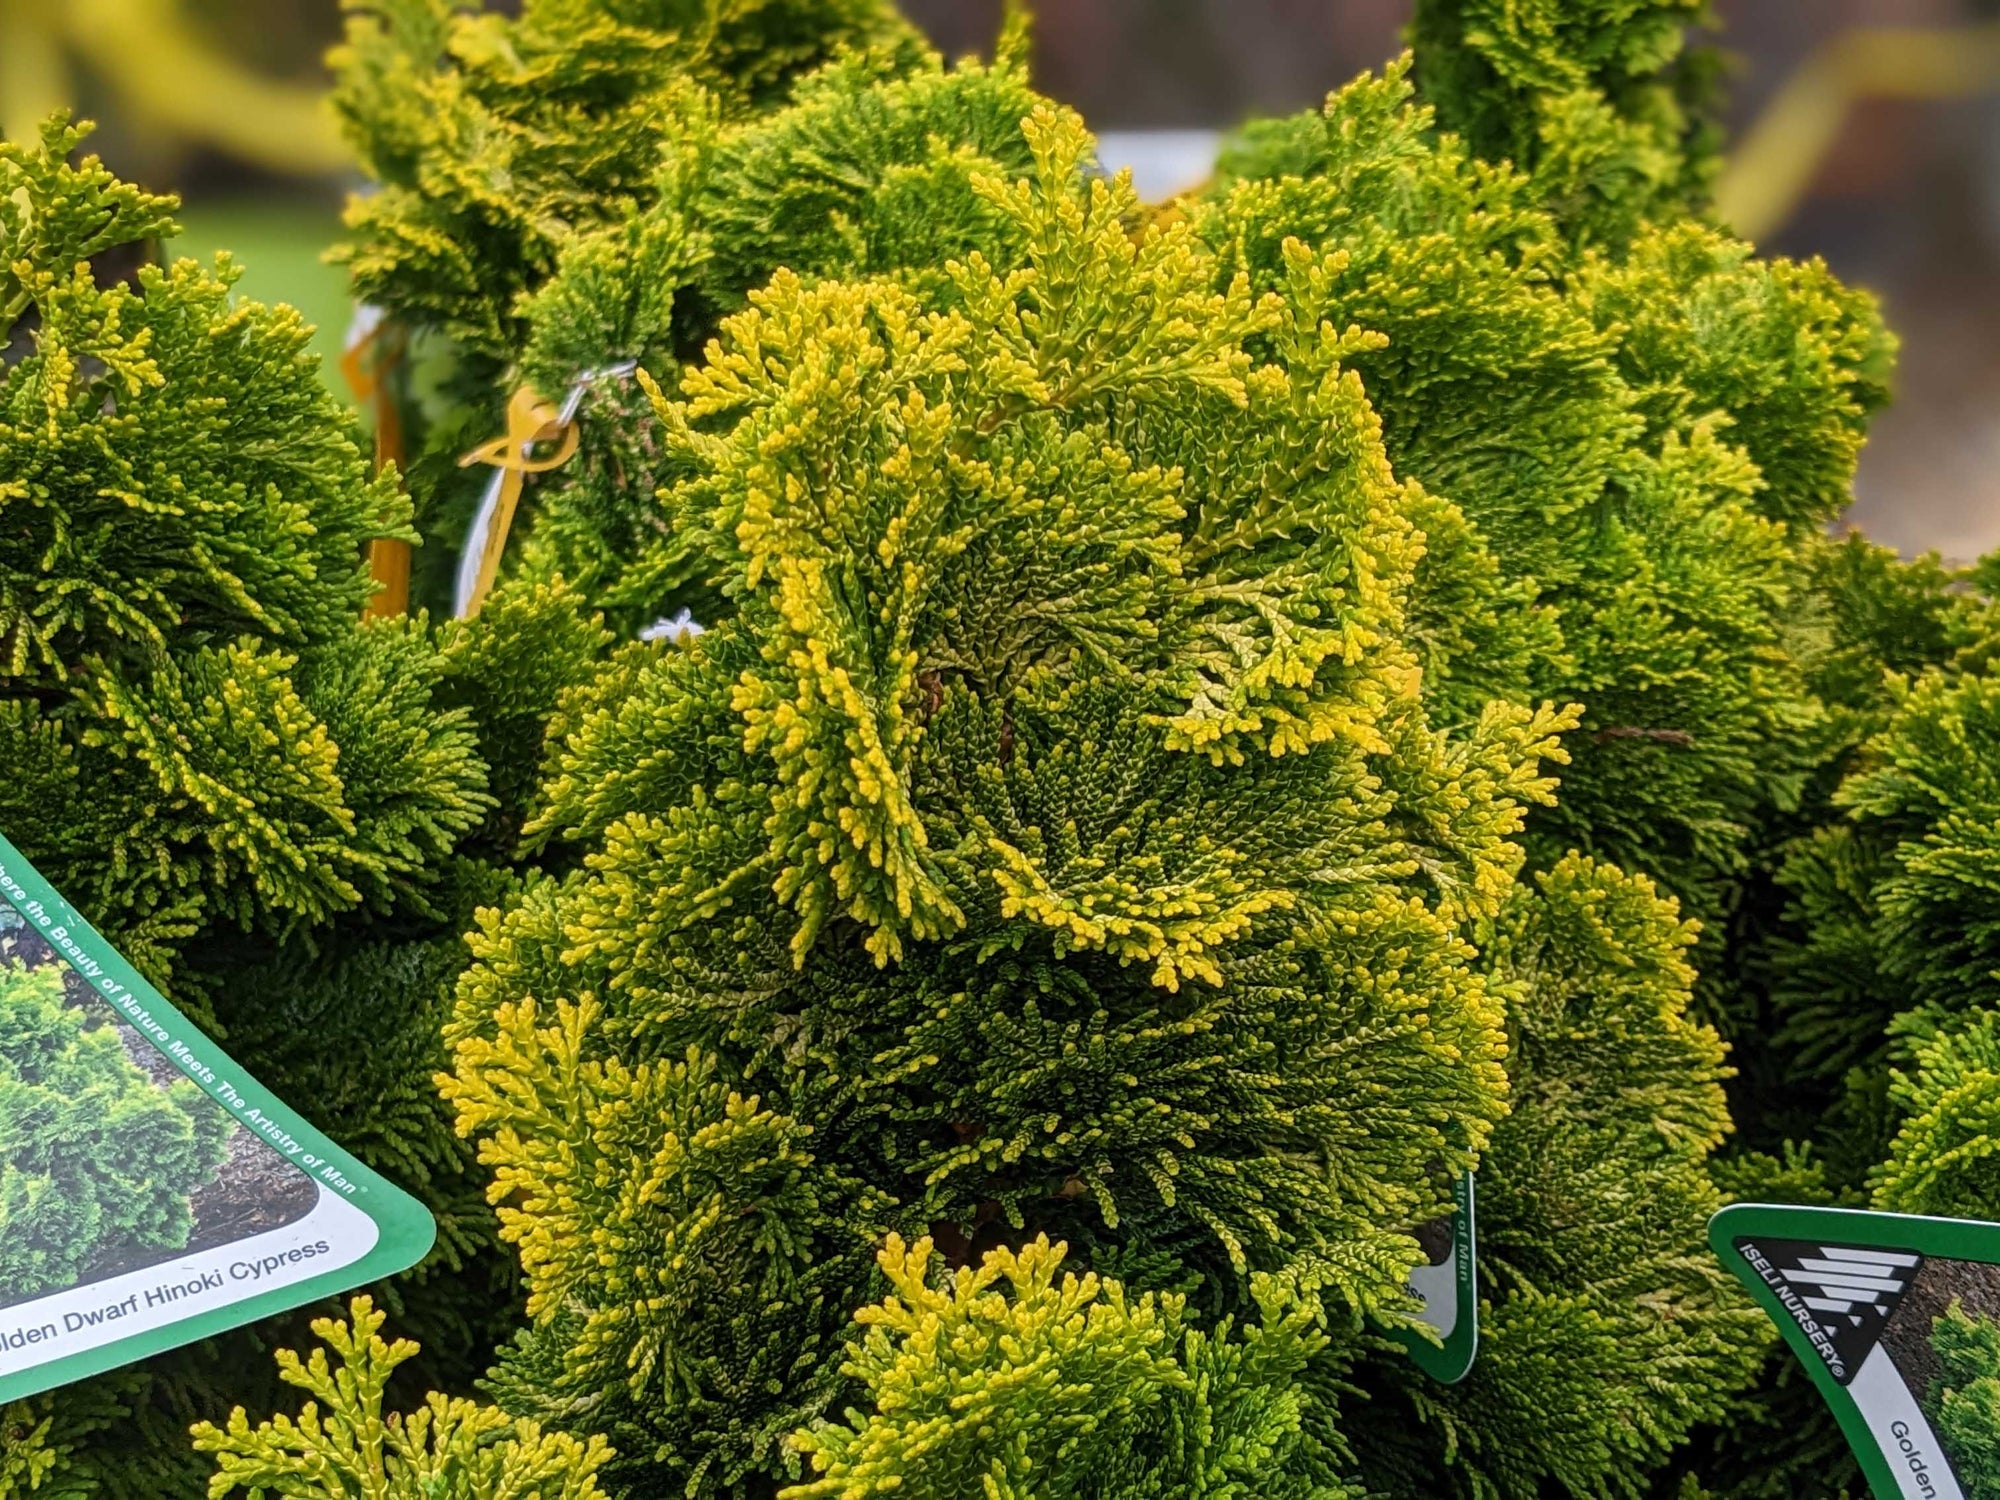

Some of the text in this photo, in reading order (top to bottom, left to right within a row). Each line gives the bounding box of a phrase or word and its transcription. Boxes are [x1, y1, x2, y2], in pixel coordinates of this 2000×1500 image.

[26, 900, 52, 927] the
[50, 926, 103, 977] Beauty
[101, 978, 125, 994] of
[118, 993, 170, 1042] Nature
[168, 1040, 216, 1084] Meets
[216, 1080, 246, 1109] The
[244, 1108, 304, 1155] Artistry
[302, 1154, 326, 1169] of
[0, 1240, 330, 1352] lden Dwarf Hinoki Cypress
[1739, 1243, 1781, 1285] ISELI
[1890, 1420, 1937, 1500] Golden
